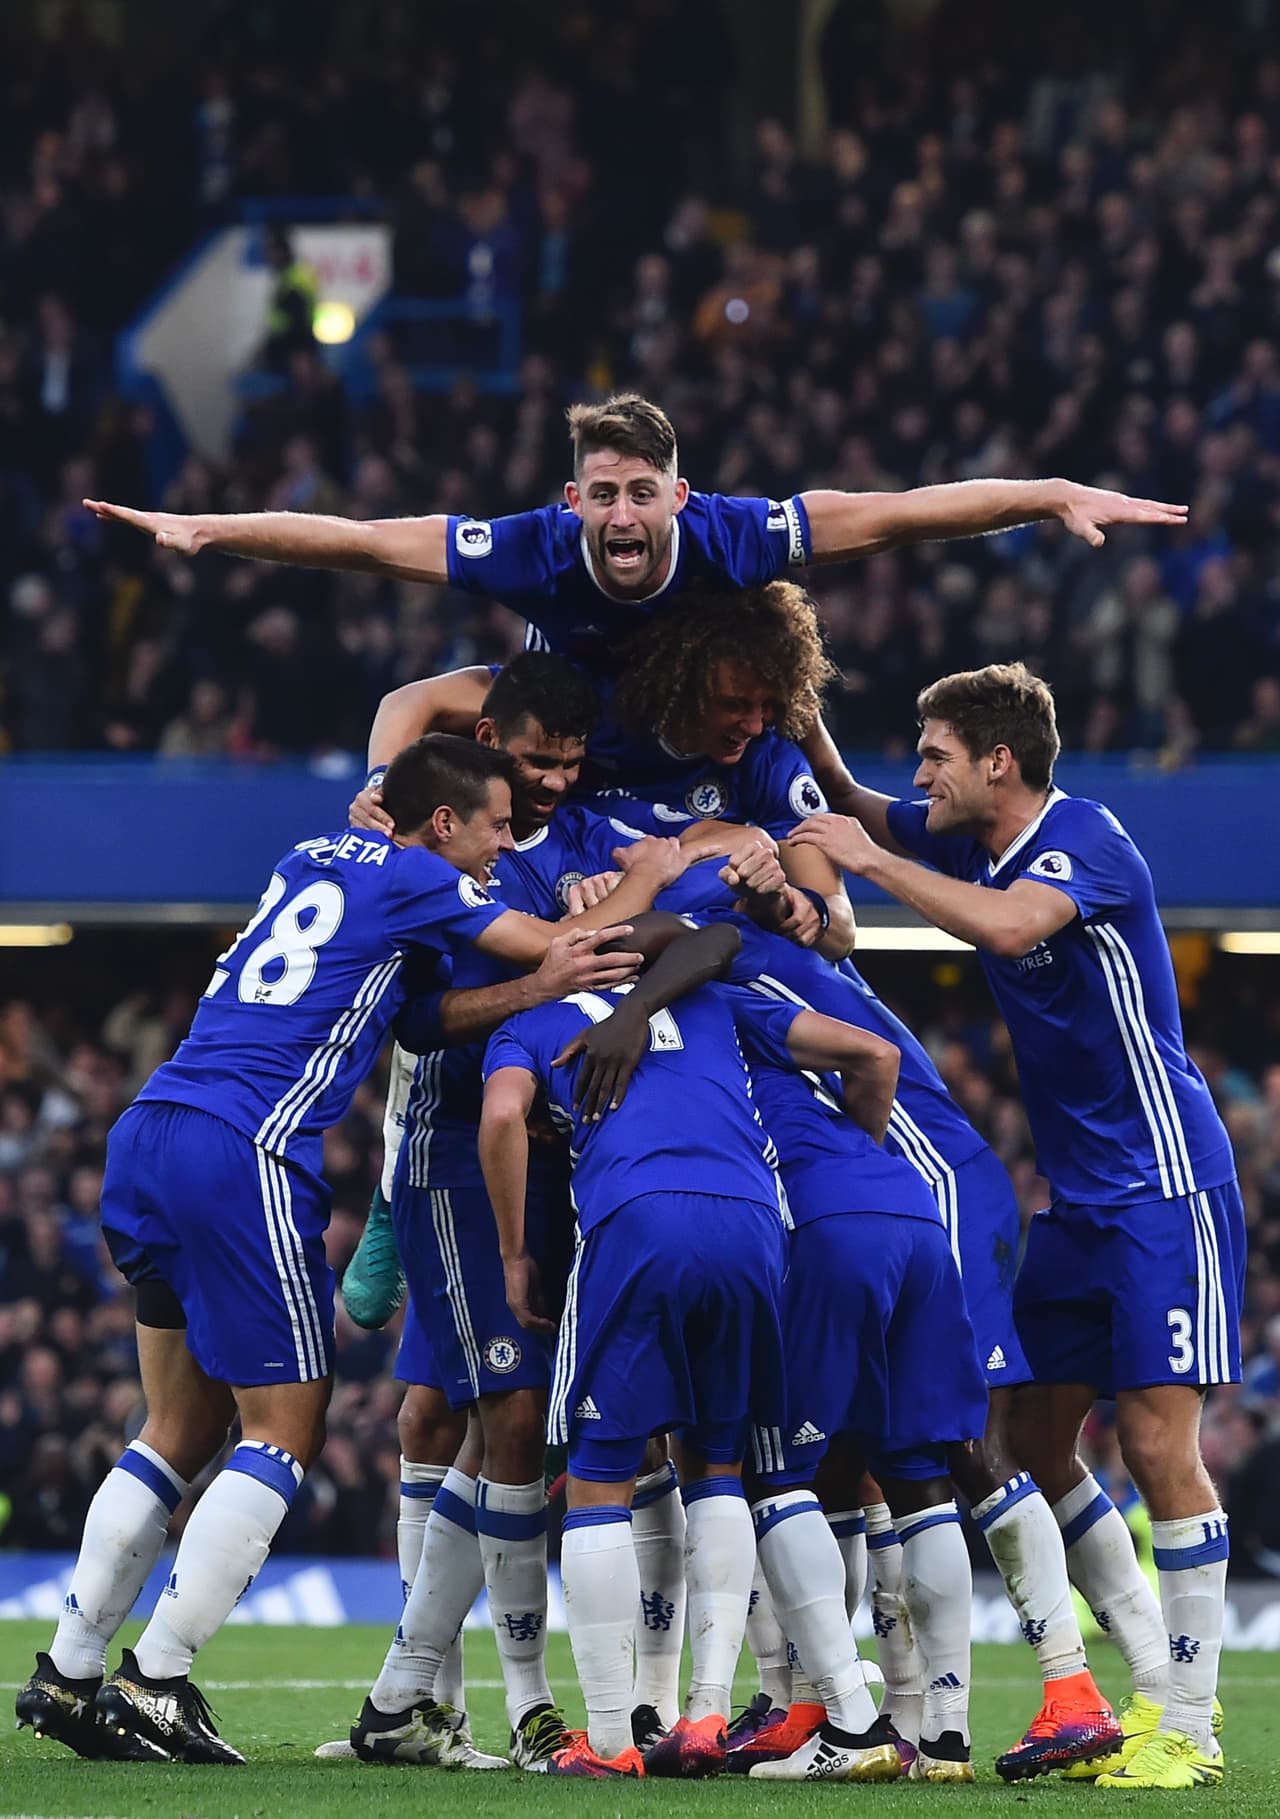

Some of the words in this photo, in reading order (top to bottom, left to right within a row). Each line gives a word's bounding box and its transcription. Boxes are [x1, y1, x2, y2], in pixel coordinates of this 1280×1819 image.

[1167, 1308, 1195, 1374] 3
[791, 1432, 826, 1446] adidas
[136, 1694, 175, 1737] adidas
[804, 1752, 849, 1781] adidas
